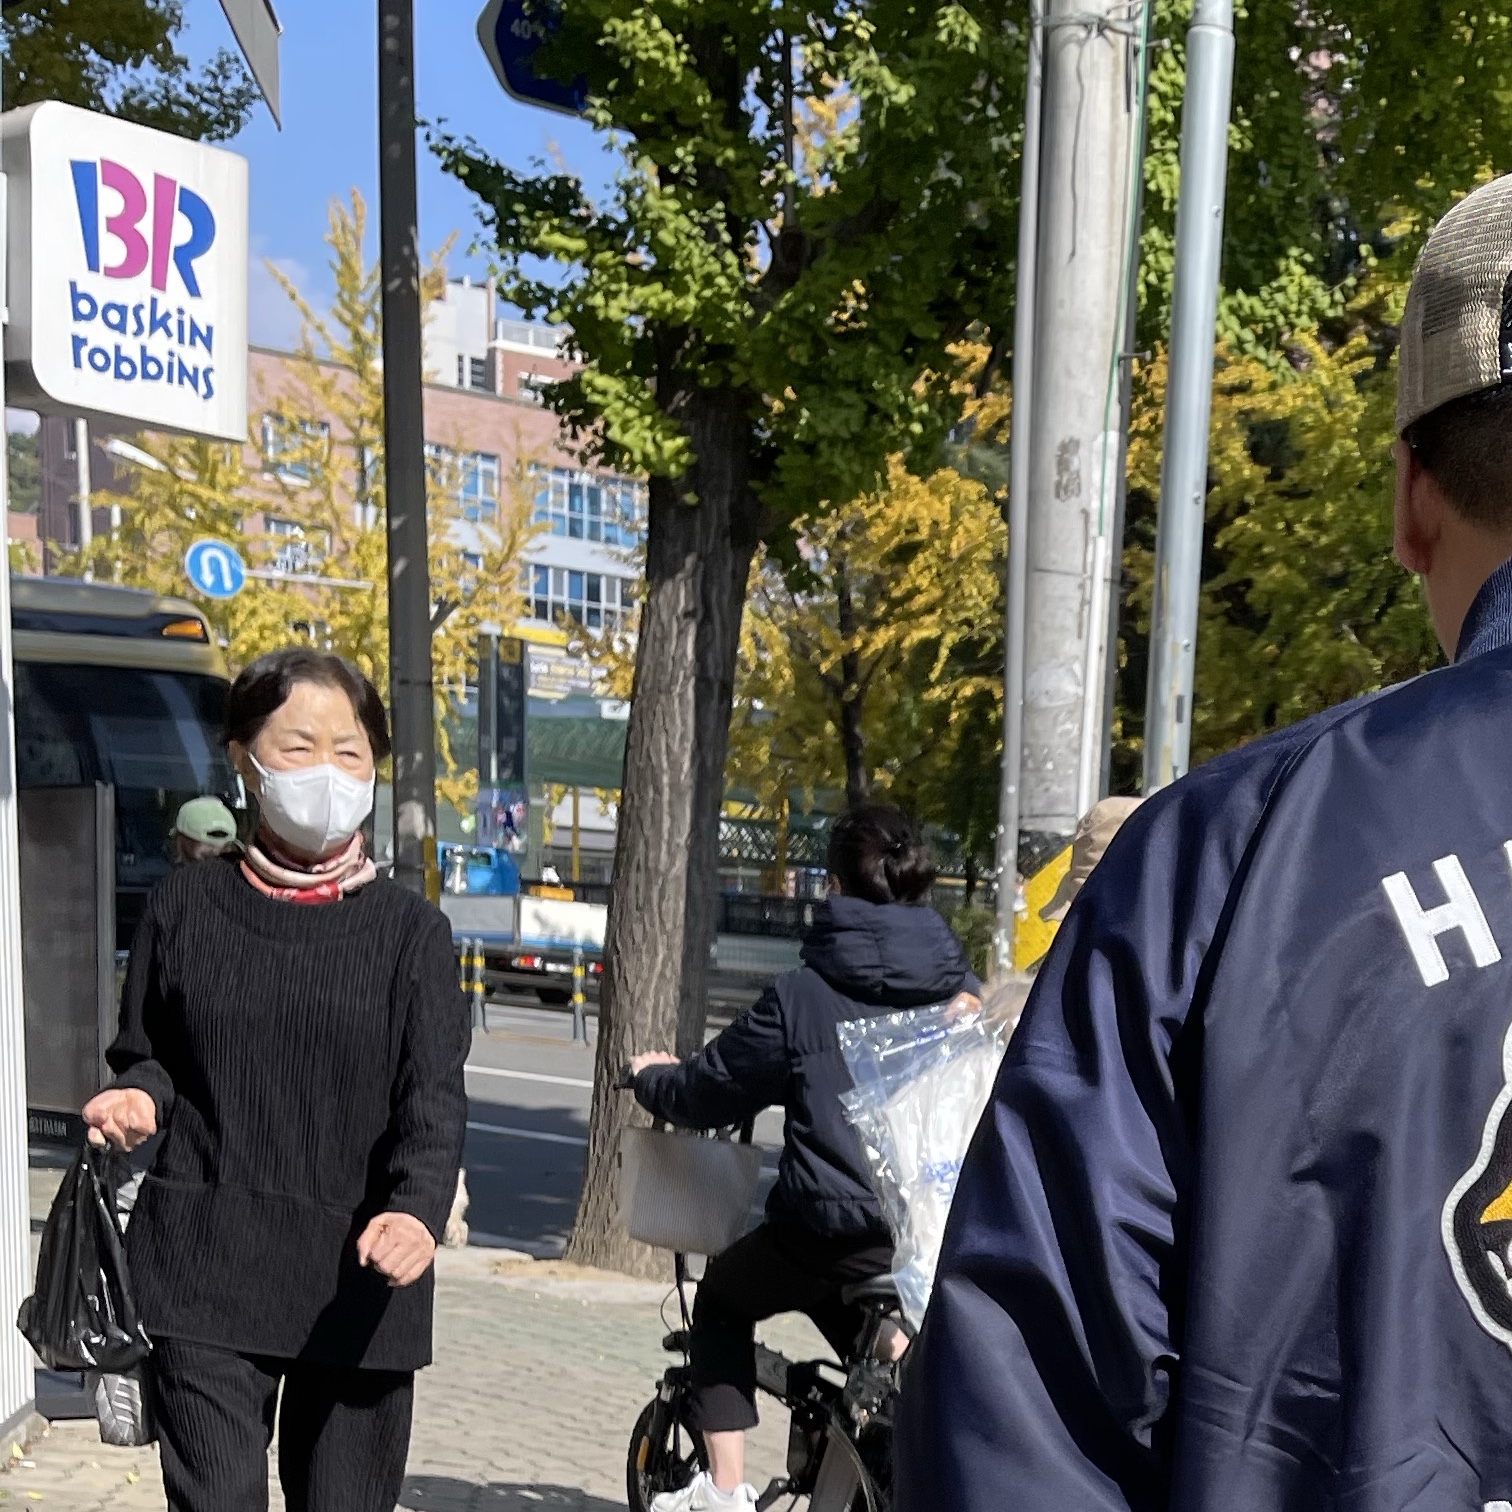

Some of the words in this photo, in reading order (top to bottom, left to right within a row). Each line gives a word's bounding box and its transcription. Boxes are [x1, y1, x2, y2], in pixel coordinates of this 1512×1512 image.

[69, 158, 216, 298] BR
[69, 280, 214, 358] baskin
[71, 333, 214, 400] robbins
